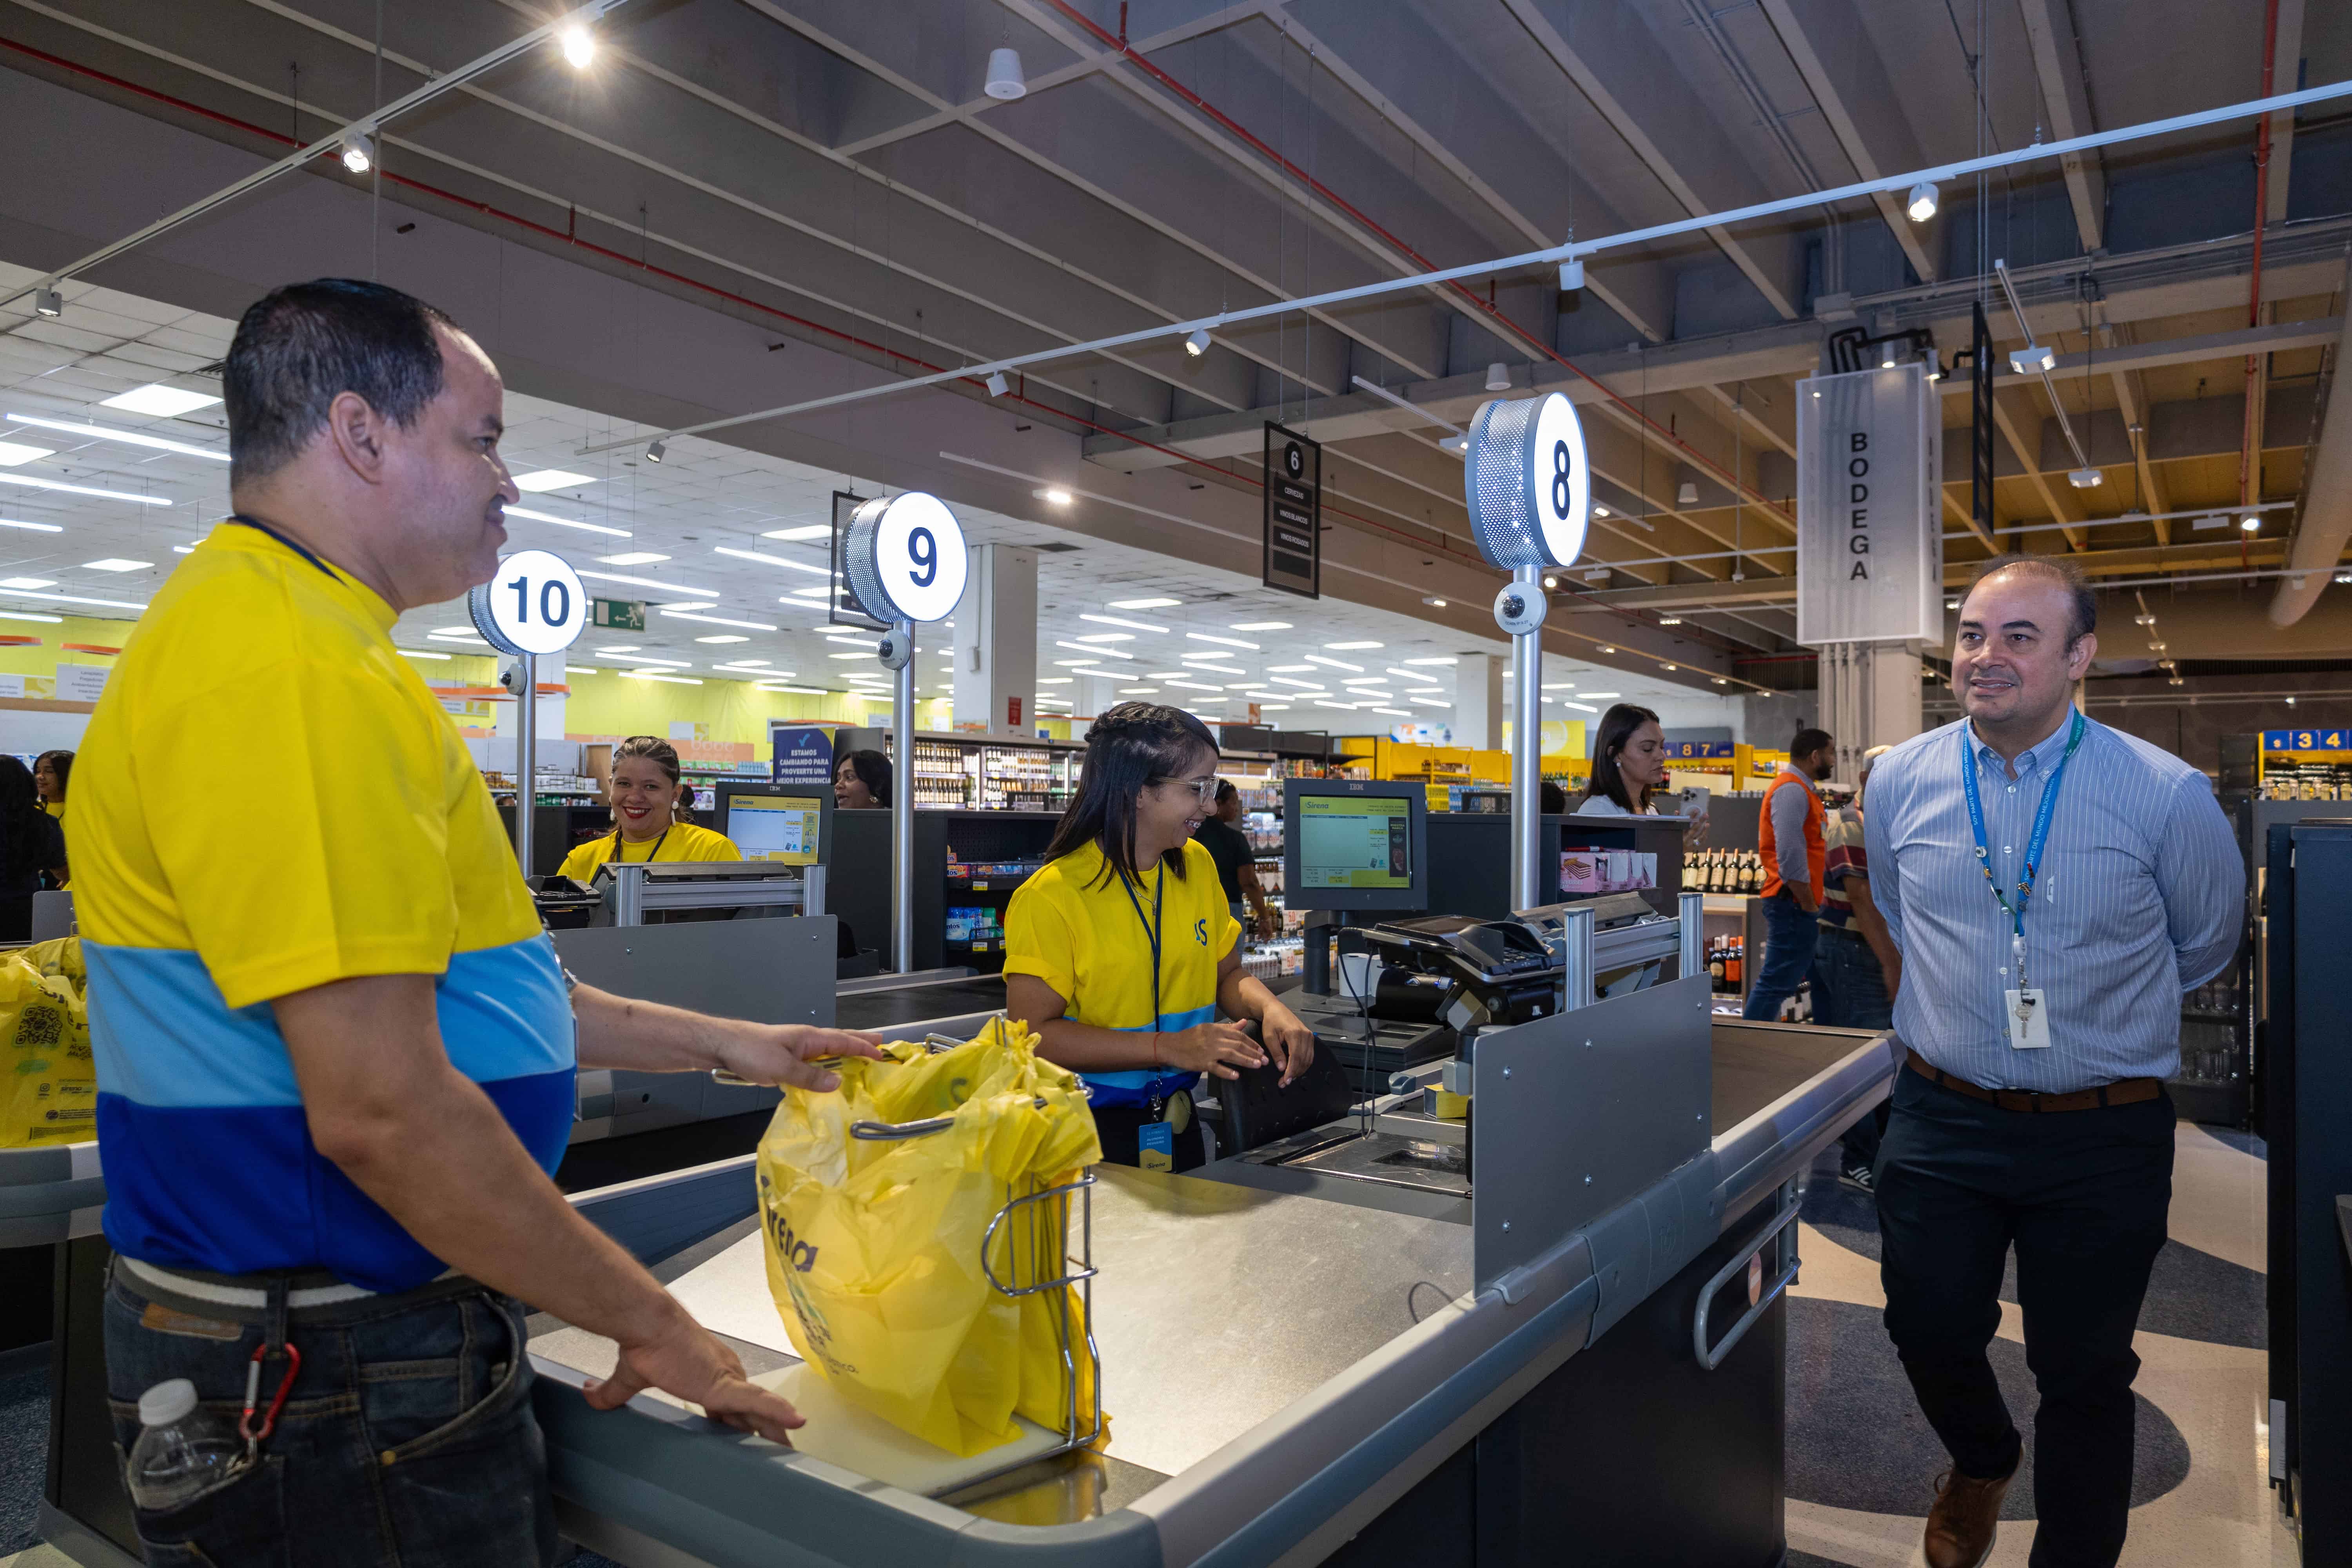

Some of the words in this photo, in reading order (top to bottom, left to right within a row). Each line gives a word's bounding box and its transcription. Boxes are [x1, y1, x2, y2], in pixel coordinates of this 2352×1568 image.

[1290, 451, 1299, 470] 6
[1552, 439, 1570, 520] 8
[1284, 487, 1305, 499] CERVEZAS
[1849, 432, 1869, 580] BODEGA
[1279, 509, 1291, 519] VINOS
[1291, 514, 1308, 524] BLANCOS
[1280, 533, 1292, 542] VINOS
[1292, 537, 1309, 548] ROSADOS
[907, 527, 937, 587] 9
[508, 576, 570, 627] 10
[2298, 733, 2312, 748] 3
[2326, 732, 2341, 748] 4
[1682, 744, 1692, 756] 8
[1701, 744, 1710, 756] 7
[2027, 850, 2036, 865] ARTE
[2035, 815, 2045, 837] MUNDO
[2041, 778, 2055, 814] MEJORAMOS
